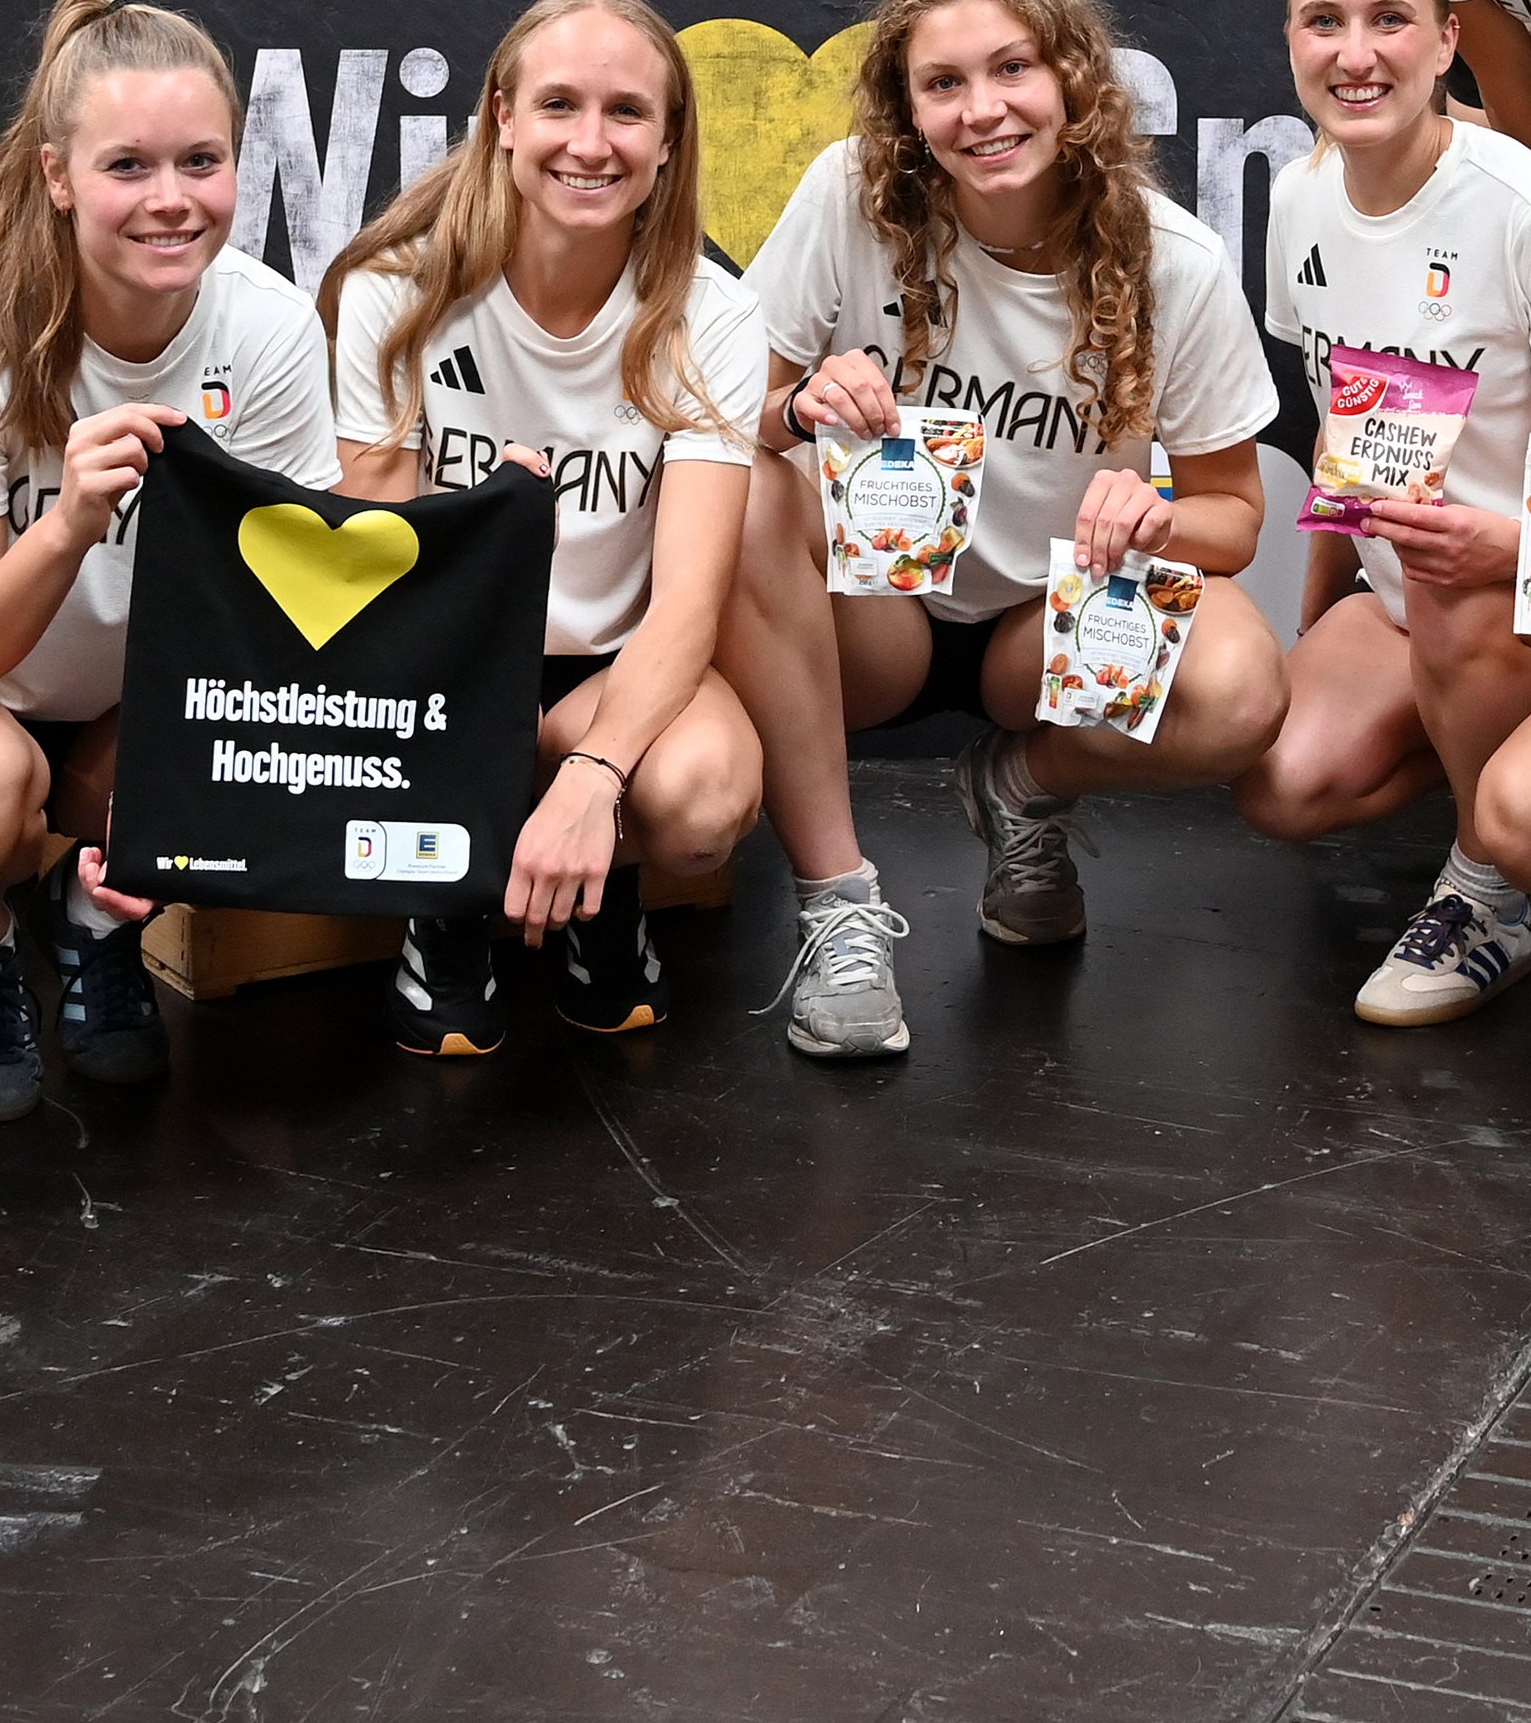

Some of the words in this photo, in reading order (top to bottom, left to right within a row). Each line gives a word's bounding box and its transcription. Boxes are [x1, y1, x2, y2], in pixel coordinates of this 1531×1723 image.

[1426, 246, 1460, 261] TEAM
[203, 364, 232, 377] EAM
[1337, 378, 1380, 409] GÜNSTIG
[1364, 417, 1438, 447] CASHEW
[1350, 436, 1434, 471] ERDNUSS
[859, 479, 933, 492] FRUCHTIGES
[1371, 463, 1410, 487] MIX
[854, 493, 938, 508] MISCHOBST
[1087, 614, 1147, 634] FRUCHTIGES
[1083, 627, 1150, 649] MISCHOBST
[184, 677, 416, 739] Höchstleistung
[424, 693, 447, 732] &
[211, 739, 411, 795] Hochgenuss.
[156, 856, 174, 870] Wir
